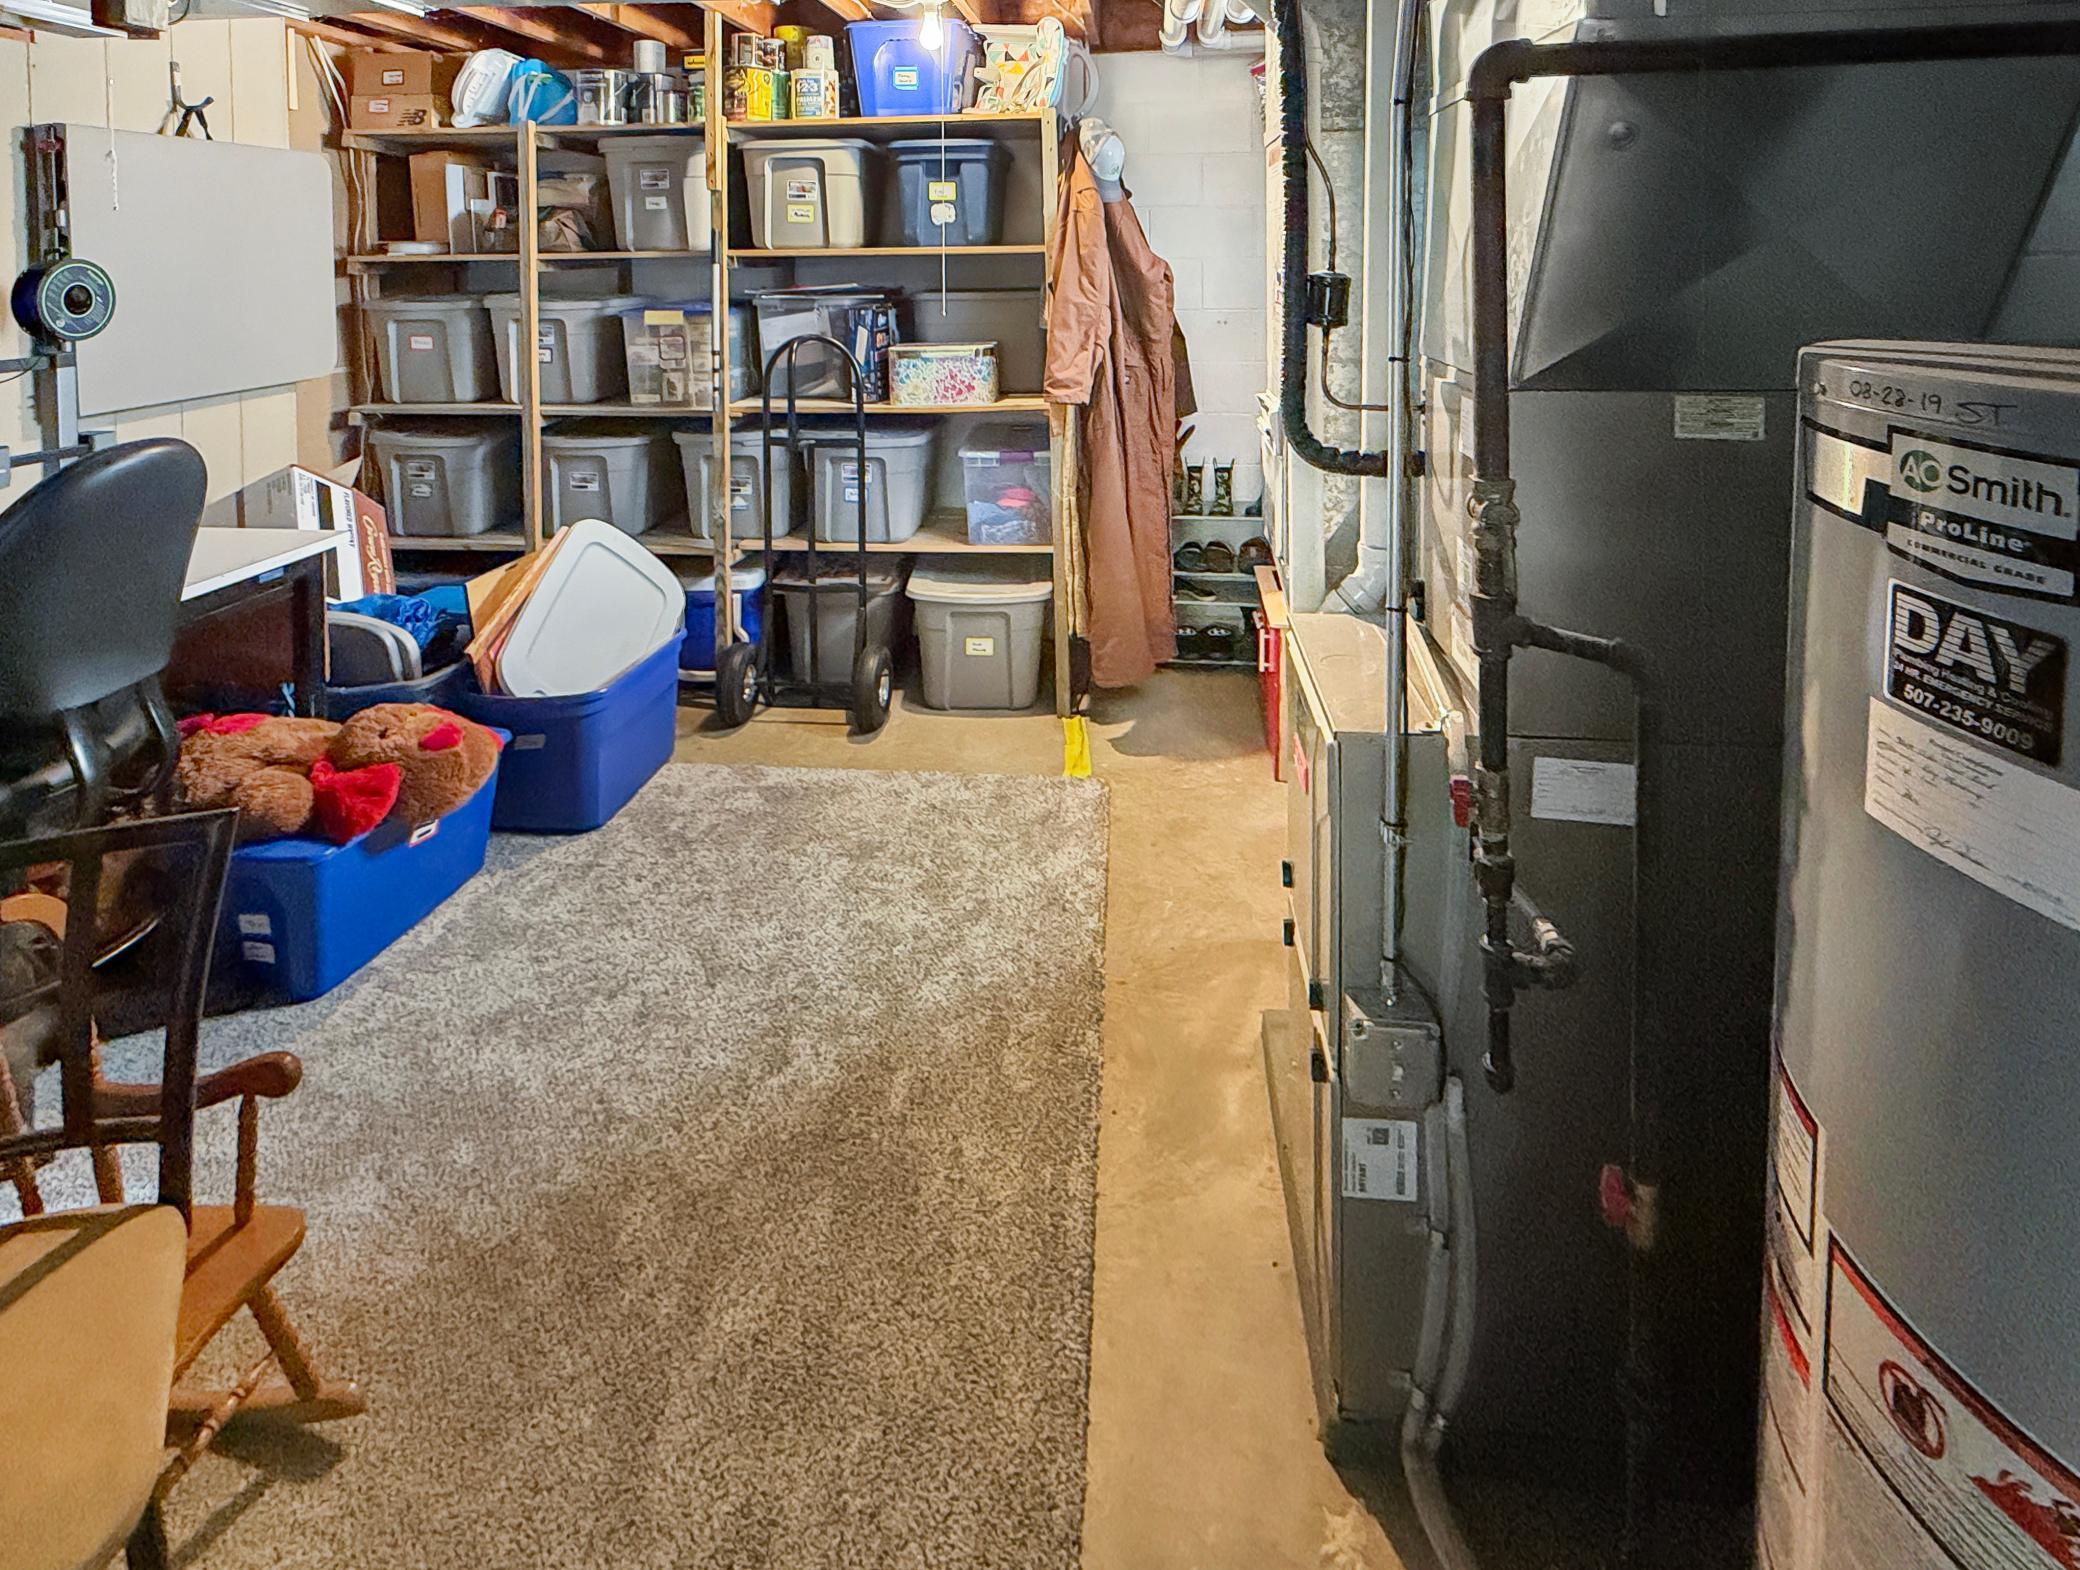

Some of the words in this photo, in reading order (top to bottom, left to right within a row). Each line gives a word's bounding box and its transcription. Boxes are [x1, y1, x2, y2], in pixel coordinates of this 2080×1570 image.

[1946, 465, 2066, 517] Smith
[1917, 510, 2026, 553] ProLine
[1907, 539, 1988, 570] COMMERCIAL
[1993, 564, 2048, 585] GRADE
[1893, 591, 2058, 694] DAY
[1903, 683, 2034, 750] 507-235-9009
